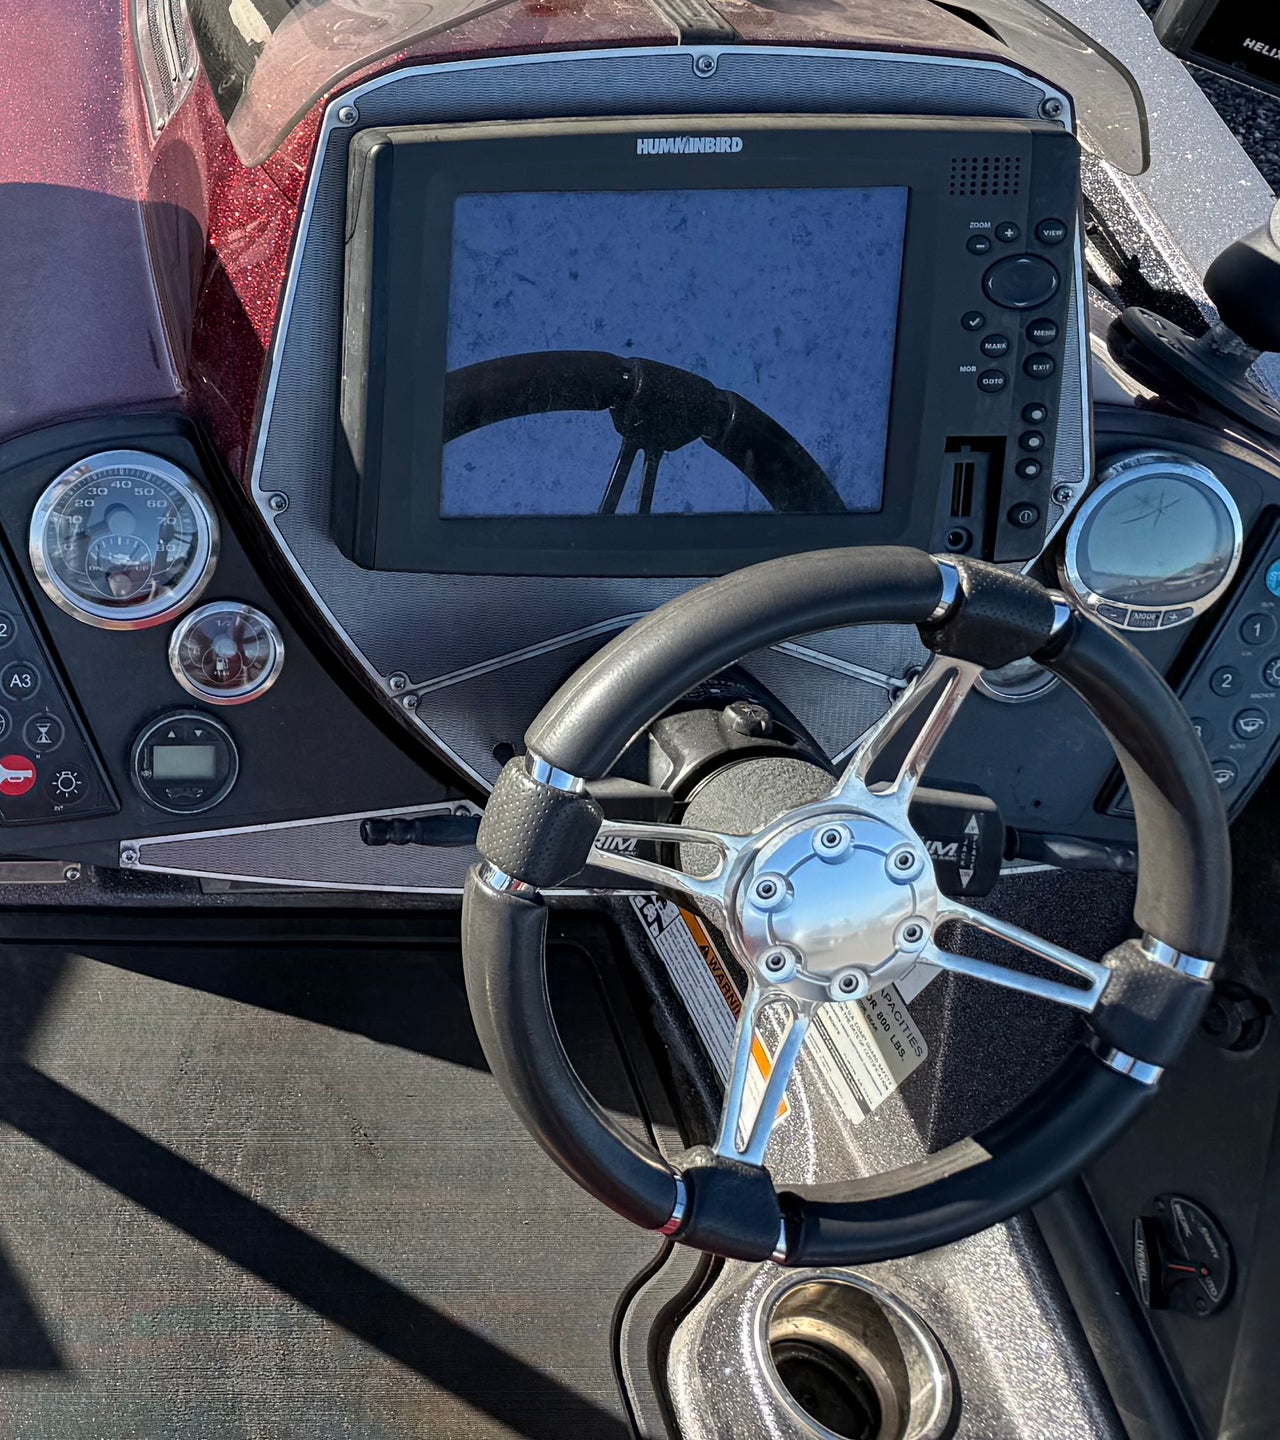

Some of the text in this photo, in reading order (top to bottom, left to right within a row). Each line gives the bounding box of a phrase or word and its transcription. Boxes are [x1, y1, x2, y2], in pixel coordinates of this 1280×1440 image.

[636, 136, 743, 155] HUMMINBIRD
[969, 221, 991, 229] ZOOM
[1043, 229, 1063, 237] VIEW
[1033, 329, 1056, 337] MENU
[984, 342, 1007, 350] MARK
[959, 365, 977, 373] MOB
[1032, 363, 1051, 372] EXIT
[982, 378, 1003, 386] GOTO
[110, 480, 132, 490] 40
[88, 487, 108, 496] 30
[134, 487, 155, 497] 50
[74, 499, 95, 508] 20
[146, 499, 168, 508] 60
[66, 515, 83, 525] 10
[157, 516, 177, 526] 70
[156, 543, 177, 553] 80
[1253, 622, 1261, 637] 1
[9, 674, 32, 688] A3
[1221, 673, 1233, 688] 2
[707, 958, 743, 1018] WARNI
[881, 989, 923, 1058] PACITIES
[875, 1011, 892, 1032] 800
[889, 1033, 908, 1062] LBS.
[1135, 1239, 1148, 1282] LIVEWELL
[1205, 1276, 1219, 1297] UTO
